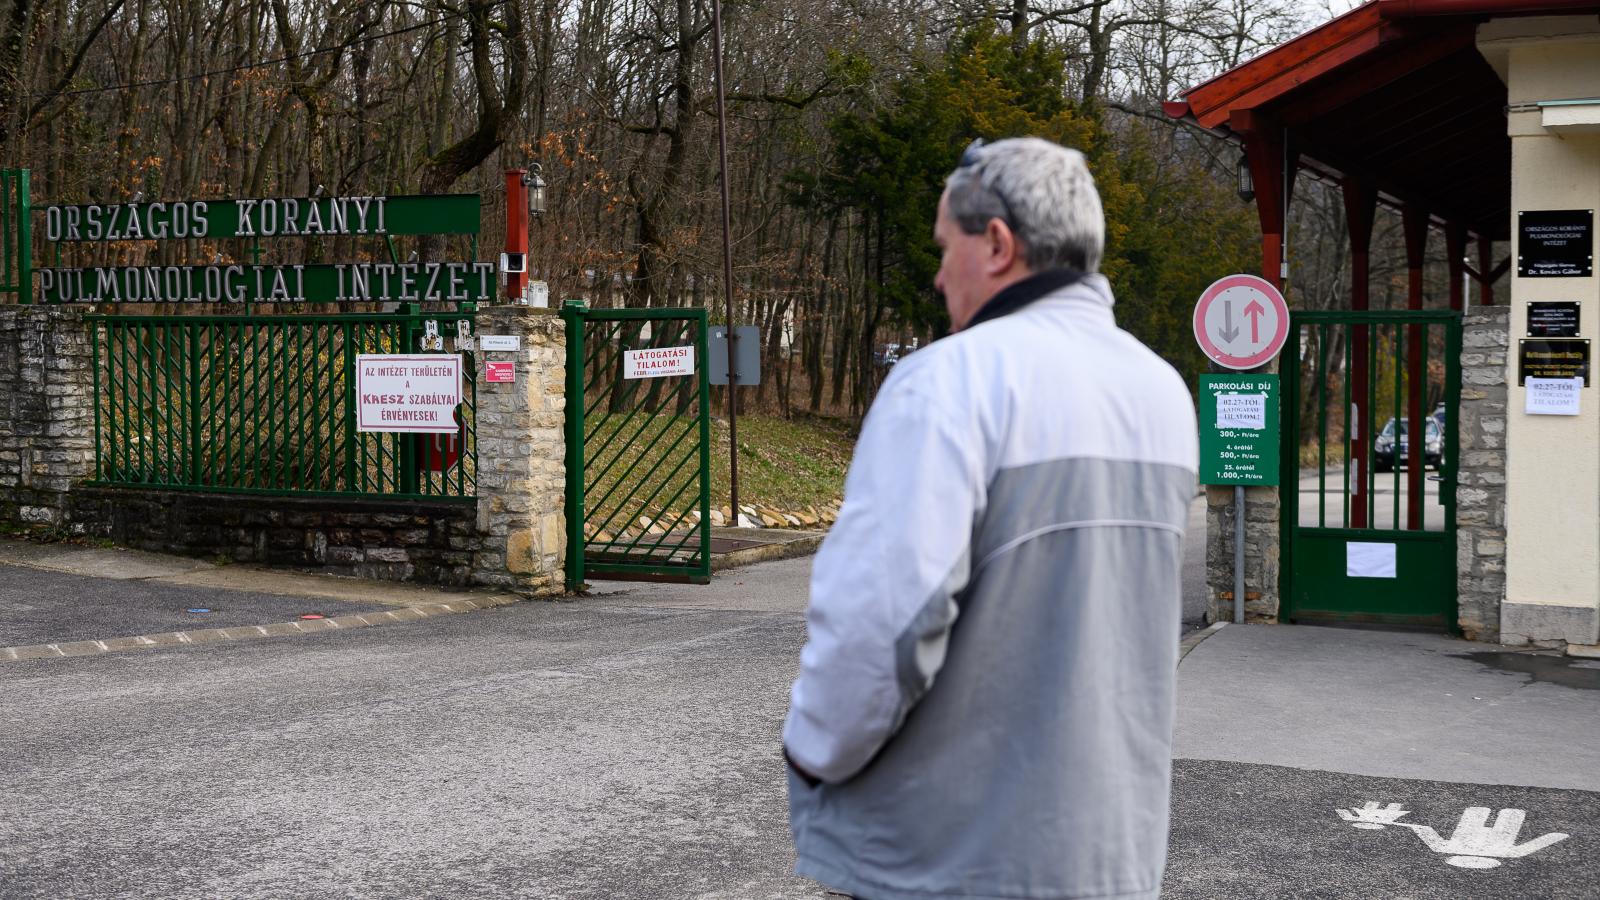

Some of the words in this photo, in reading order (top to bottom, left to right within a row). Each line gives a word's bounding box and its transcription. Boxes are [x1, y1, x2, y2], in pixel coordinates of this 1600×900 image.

[633, 348, 687, 360] LÁTOGATÁSI
[637, 360, 680, 369] TILALOM!
[365, 367, 375, 377] AZ
[378, 365, 408, 377] INTÉZET
[411, 365, 453, 377] TERÜLETÉN
[405, 380, 410, 389] A
[1208, 381, 1253, 390] PARKOLÁSI
[1258, 381, 1271, 390] DÍJ
[363, 394, 405, 405] KRESZ
[409, 392, 455, 405] SZABÁLYAI
[381, 408, 438, 421] ÉRVÉNYESEK!
[1216, 472, 1244, 480] 1.000,-
